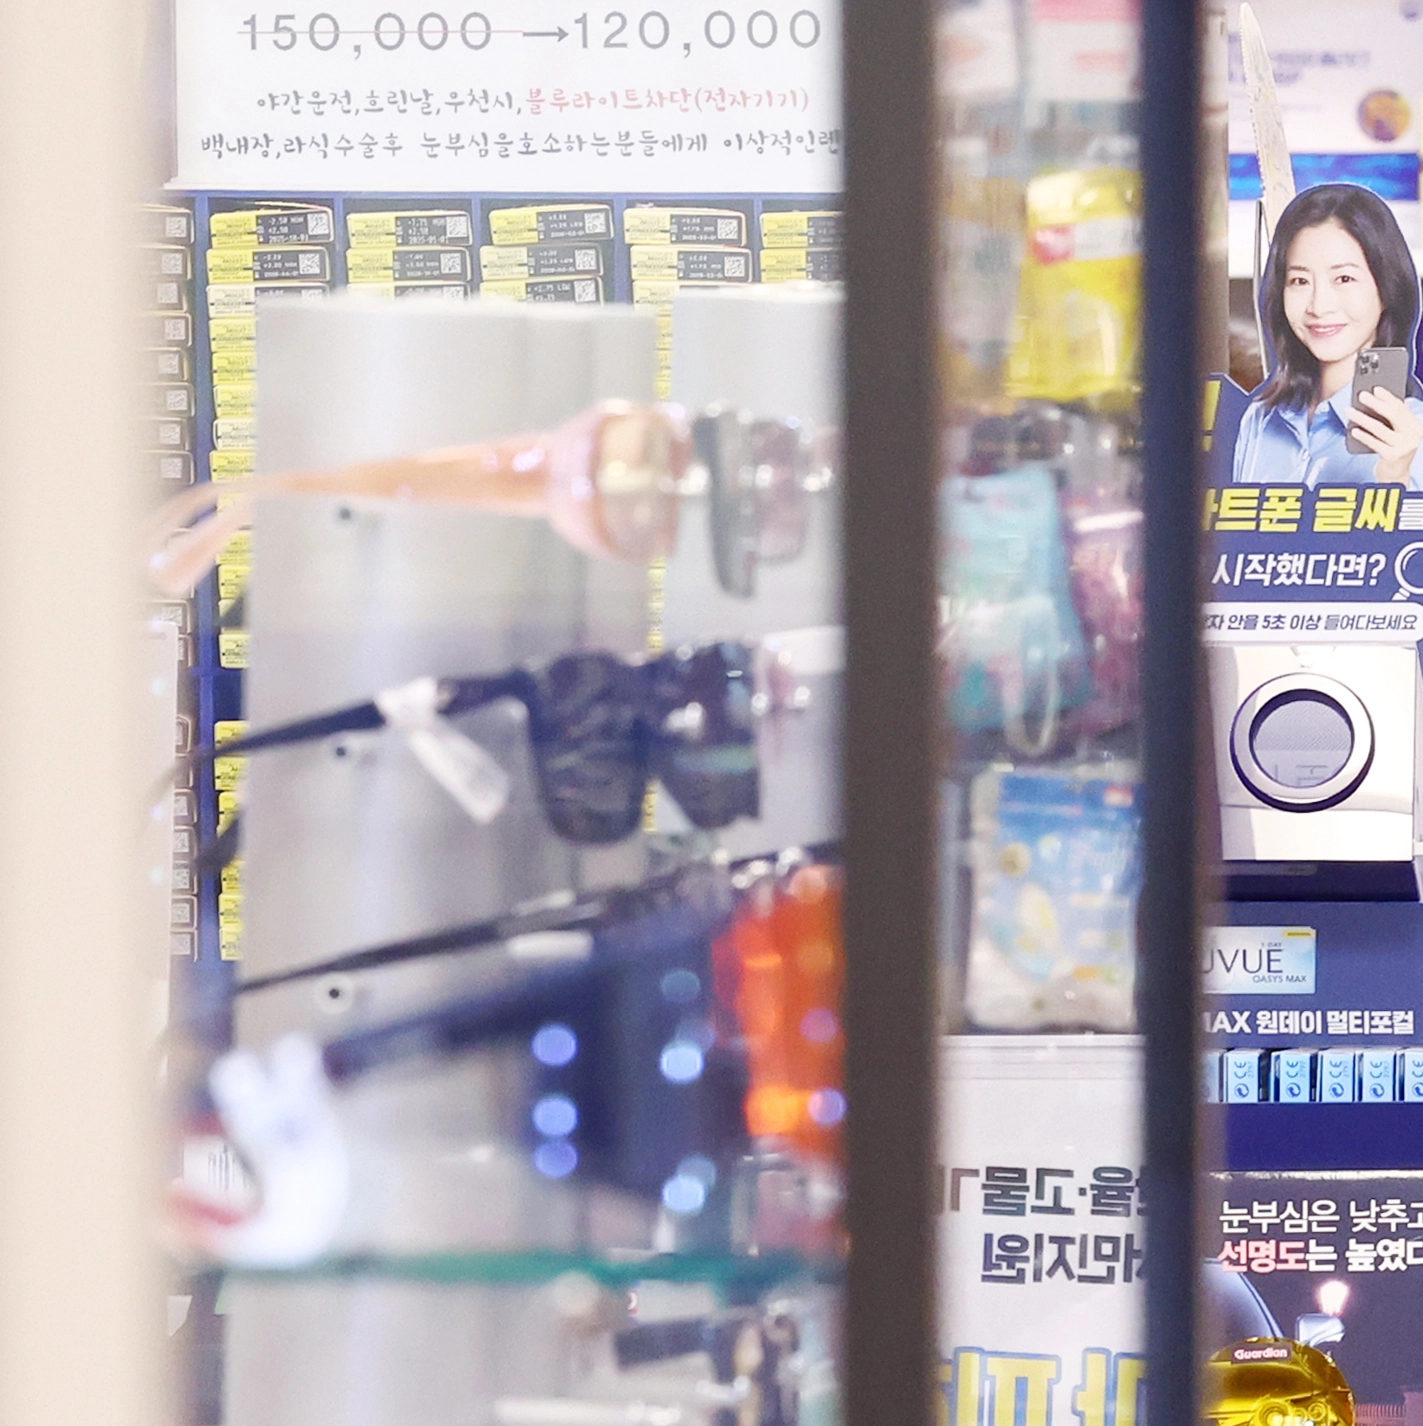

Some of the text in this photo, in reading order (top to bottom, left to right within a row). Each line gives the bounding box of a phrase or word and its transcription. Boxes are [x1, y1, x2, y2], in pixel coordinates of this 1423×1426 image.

[242, 10, 821, 60] 150,000 120,000
[724, 130, 839, 156] 이상적인렌
[1211, 552, 1387, 586] 시작했다면?
[1227, 614, 1259, 630] 안을
[1262, 614, 1286, 630] 5초
[1289, 614, 1321, 630] 이상
[1324, 614, 1418, 630] 들여다보세요
[1285, 974, 1307, 983] MAX
[1256, 1010, 1323, 1034] 원데이
[1326, 1010, 1414, 1035] 멀티포컬
[1219, 1199, 1340, 1234] 눈부심은
[1218, 1238, 1338, 1273] 선명도는
[1233, 1346, 1288, 1361] Guardian
